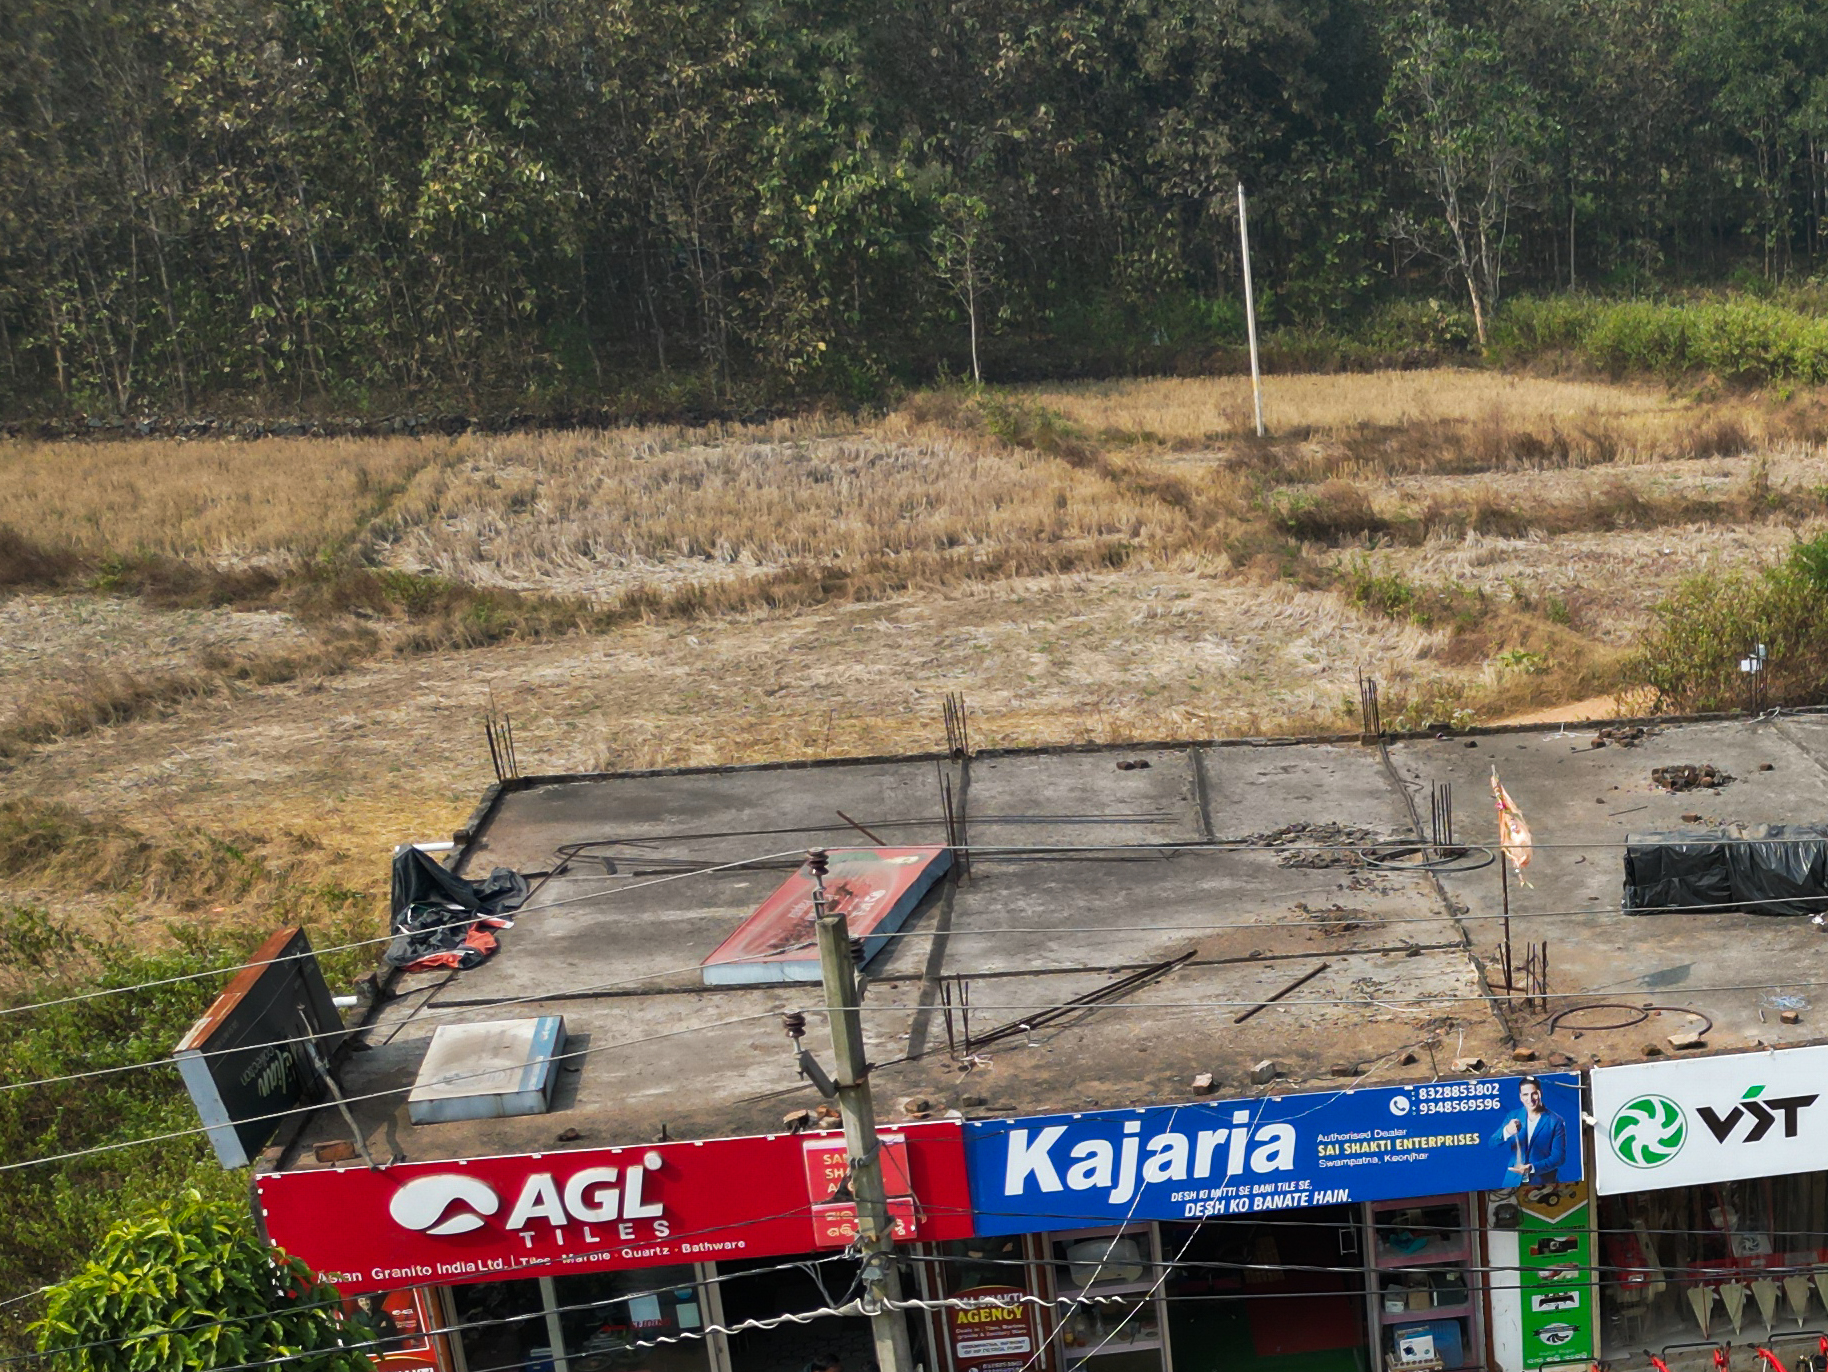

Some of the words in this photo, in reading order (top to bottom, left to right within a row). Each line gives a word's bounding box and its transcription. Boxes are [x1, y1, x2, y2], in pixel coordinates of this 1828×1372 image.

[1419, 1083, 1500, 1100] 8328853802
[1419, 1098, 1501, 1115] 9348569596
[1695, 1084, 1820, 1145] VST
[1317, 1130, 1371, 1143] Authorised
[1374, 1128, 1408, 1138] Dealer
[1318, 1144, 1340, 1157] SAI
[1344, 1139, 1392, 1155] SHAKTI
[1395, 1132, 1480, 1150] ENTERPRISES
[1004, 1110, 1297, 1204] Kajaria
[505, 1164, 664, 1230] AGL
[1171, 1190, 1197, 1201] DESH
[1239, 1185, 1251, 1196] SE
[1253, 1182, 1275, 1193] BANI
[1277, 1181, 1296, 1192] TILE
[1299, 1179, 1313, 1190] SE,
[1185, 1199, 1225, 1217] DESH
[1229, 1198, 1250, 1213] KO
[1253, 1191, 1310, 1211] BANATE
[1313, 1188, 1352, 1205] HAIN.
[519, 1220, 670, 1248] TILES
[317, 1270, 363, 1285] Asian
[371, 1263, 432, 1281] Granito
[437, 1261, 476, 1275] India
[478, 1257, 509, 1271] Ltd.
[622, 1246, 670, 1260] Quartz
[682, 1239, 746, 1254] Bathware
[957, 1305, 1024, 1324] AGENCY
